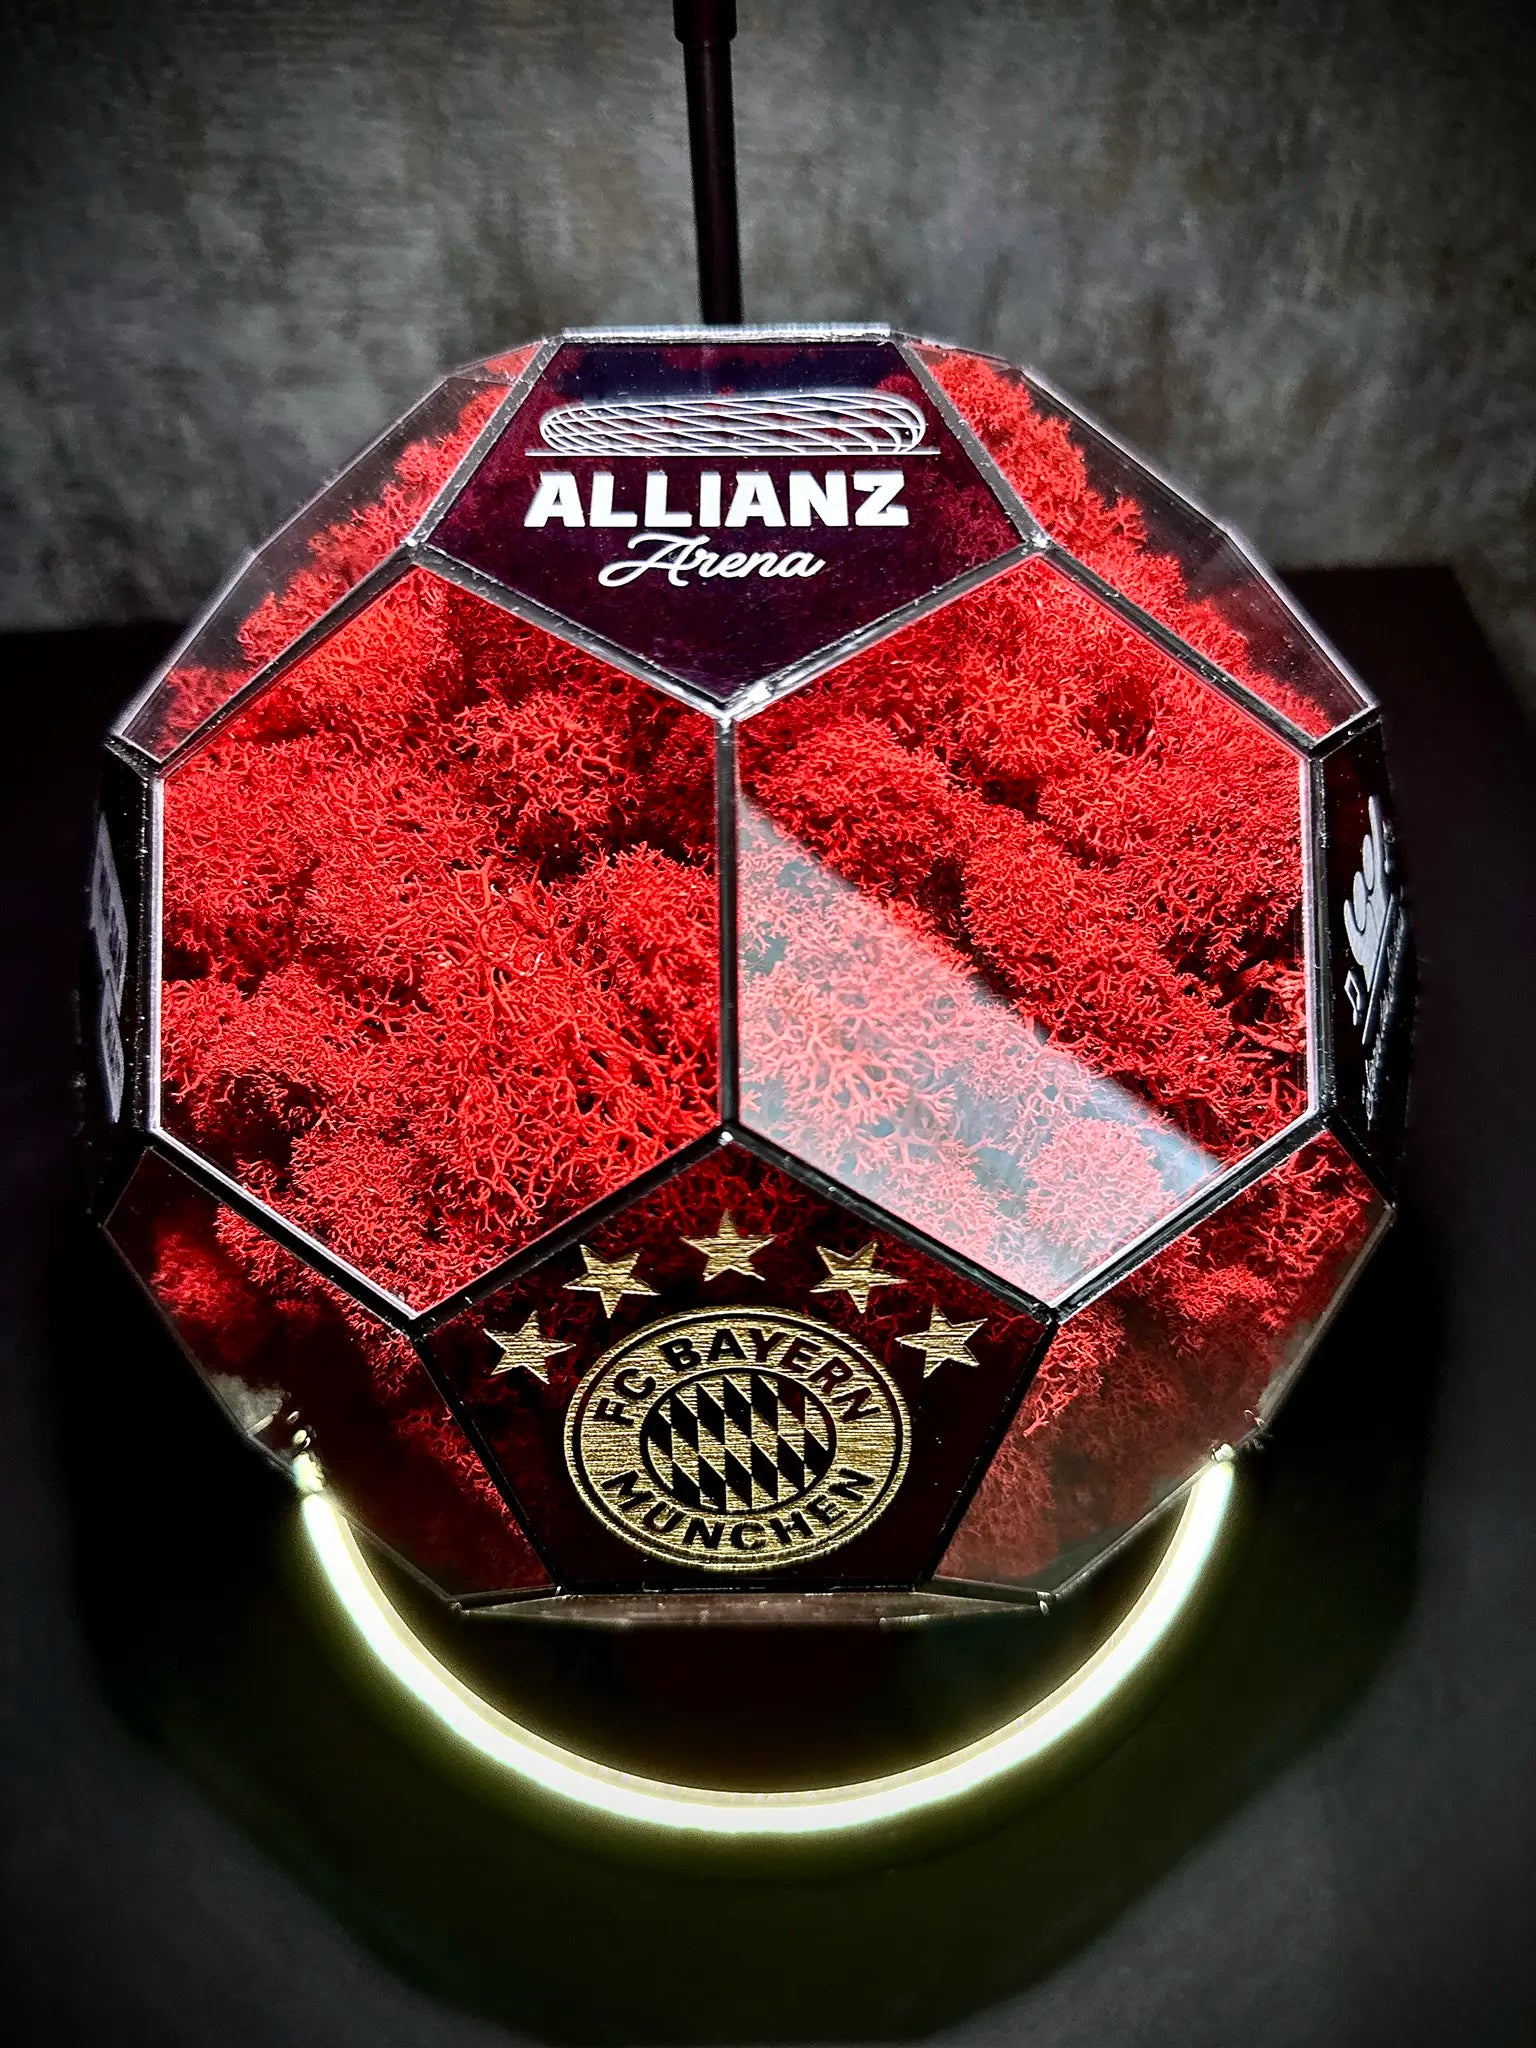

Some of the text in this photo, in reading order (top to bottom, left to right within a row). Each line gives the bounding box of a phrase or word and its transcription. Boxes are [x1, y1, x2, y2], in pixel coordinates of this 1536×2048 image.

[523, 471, 909, 527] ALLIANZ
[598, 532, 826, 587] Arena
[594, 1328, 881, 1426] FC BAYERN
